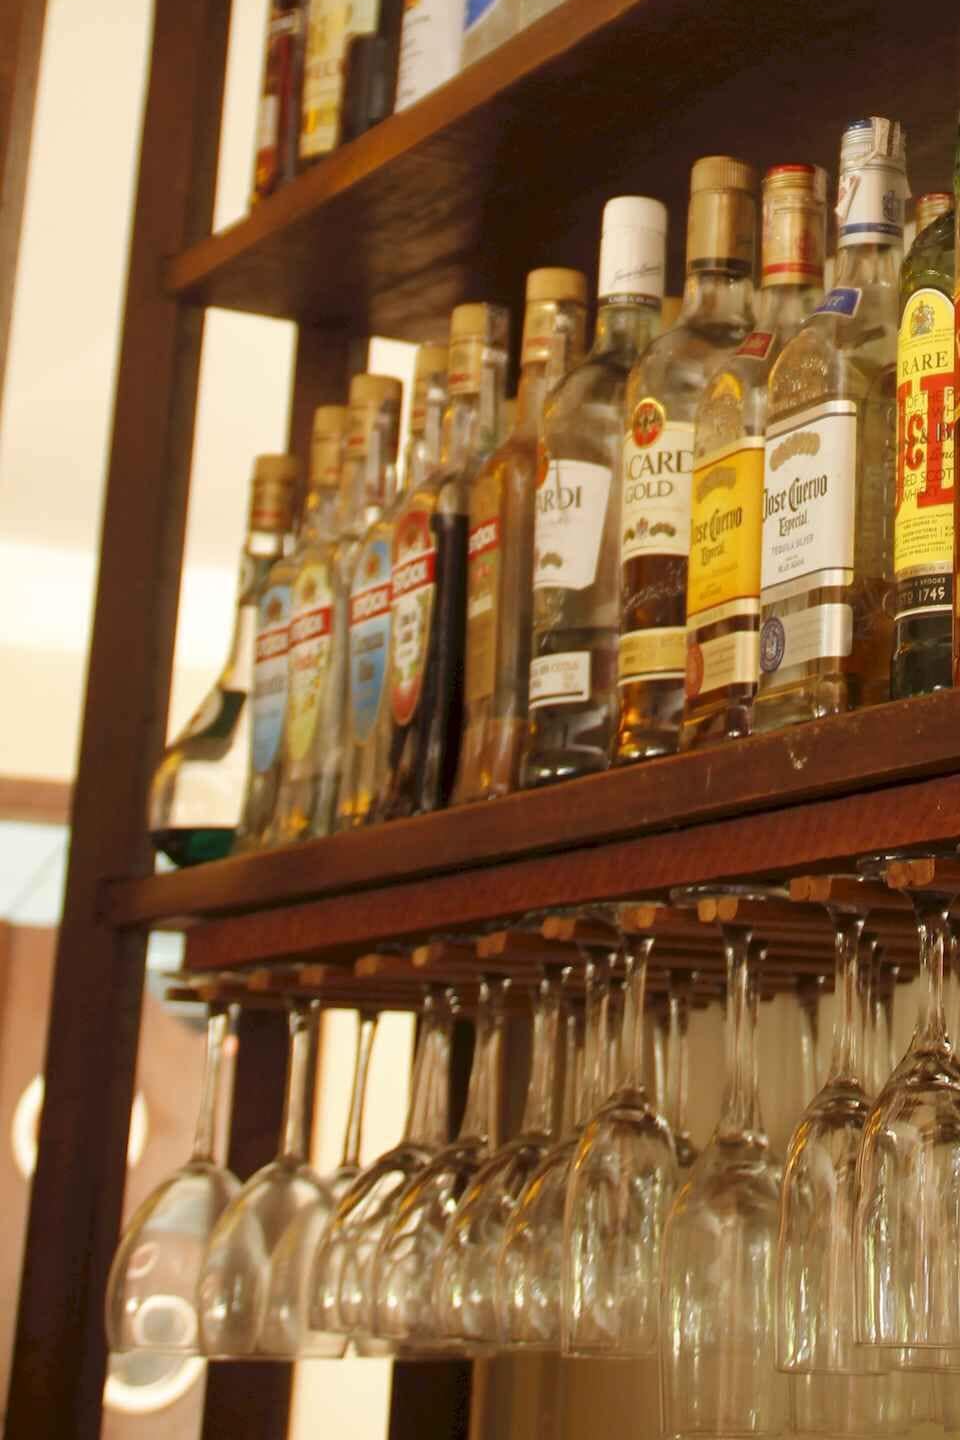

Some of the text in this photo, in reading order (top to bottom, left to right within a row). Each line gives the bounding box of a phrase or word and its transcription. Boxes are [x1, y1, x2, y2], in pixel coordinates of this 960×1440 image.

[902, 351, 949, 378] RARE
[625, 480, 674, 505] GOLD
[788, 474, 828, 512] Cuervo
[918, 586, 946, 602] 1745
